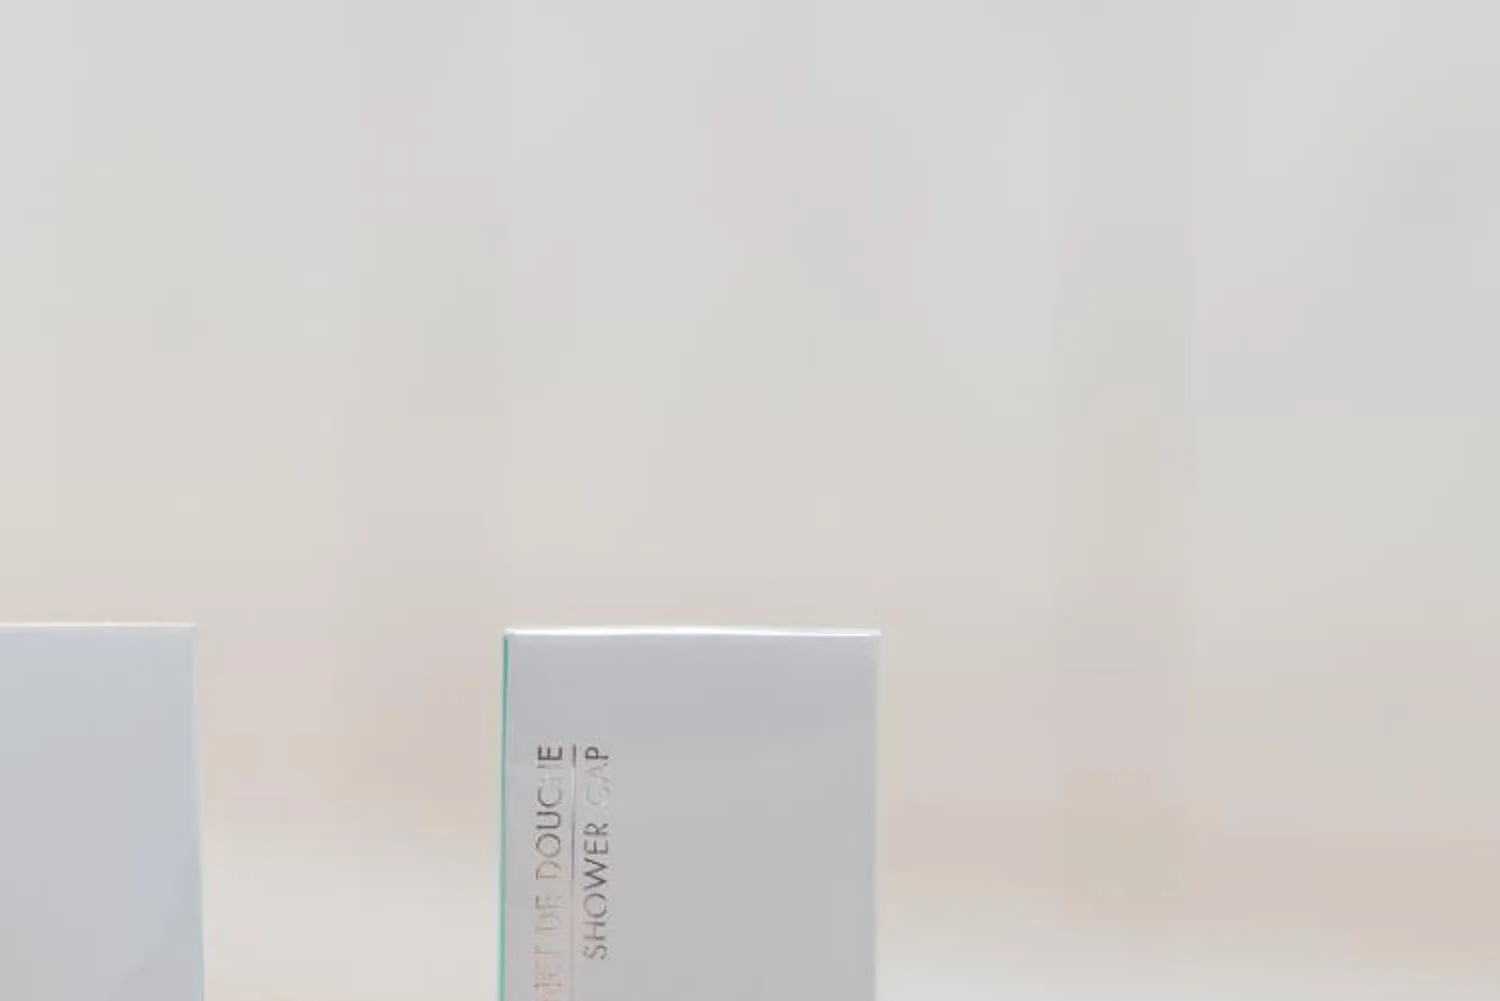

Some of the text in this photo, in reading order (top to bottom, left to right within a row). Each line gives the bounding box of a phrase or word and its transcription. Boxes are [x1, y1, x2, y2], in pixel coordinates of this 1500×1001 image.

[535, 895, 563, 935] DE
[582, 746, 611, 960] SHOWER CAP
